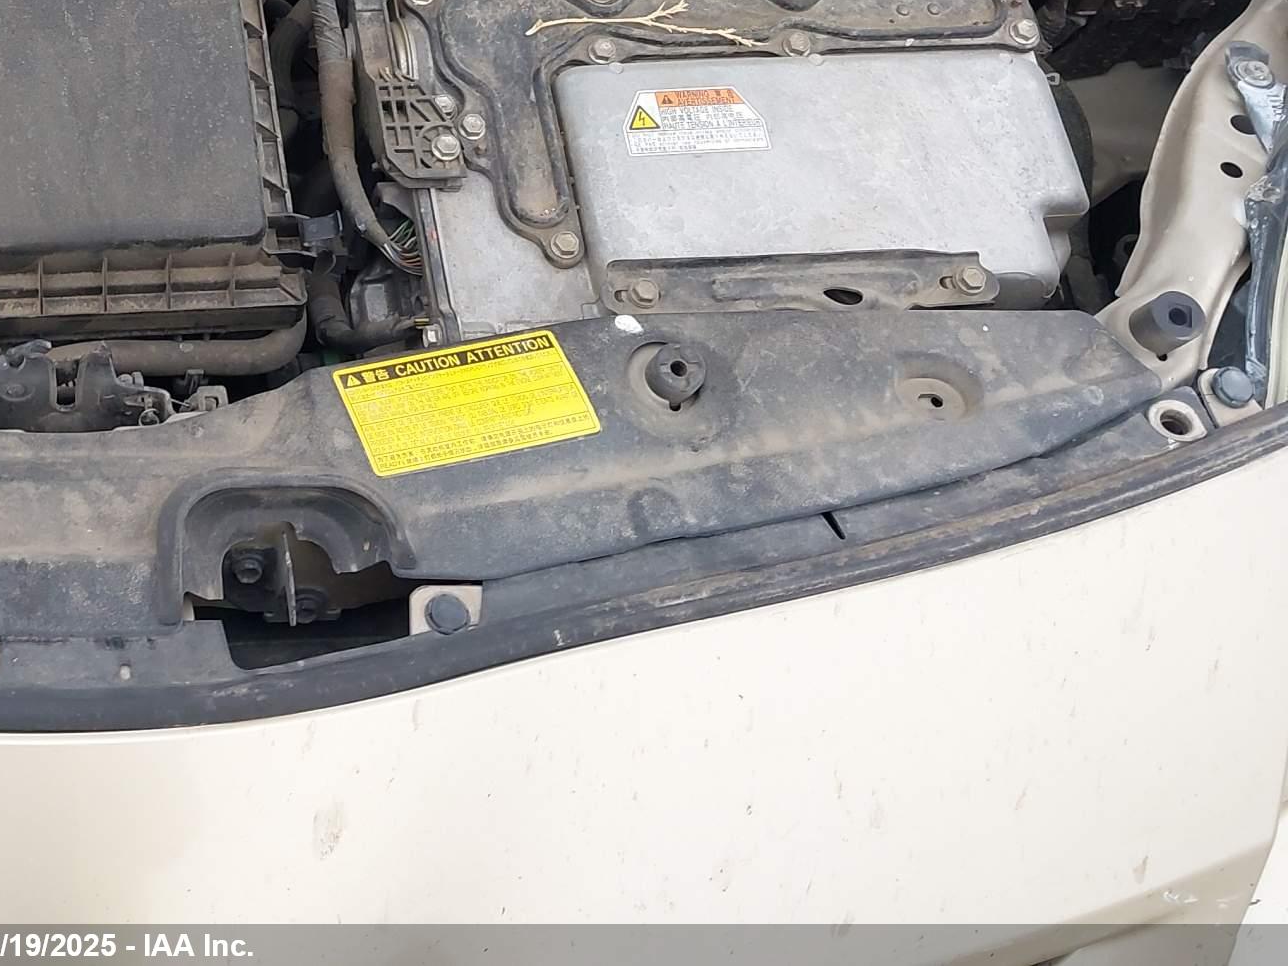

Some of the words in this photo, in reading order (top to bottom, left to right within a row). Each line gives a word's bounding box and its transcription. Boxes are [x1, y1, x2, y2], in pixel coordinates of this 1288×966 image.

[680, 107, 709, 115] VOLTAGE
[712, 105, 734, 113] INSIDE
[689, 120, 714, 129] TENSION
[395, 353, 461, 377] CAUTION
[466, 336, 551, 364] ATTENTION
